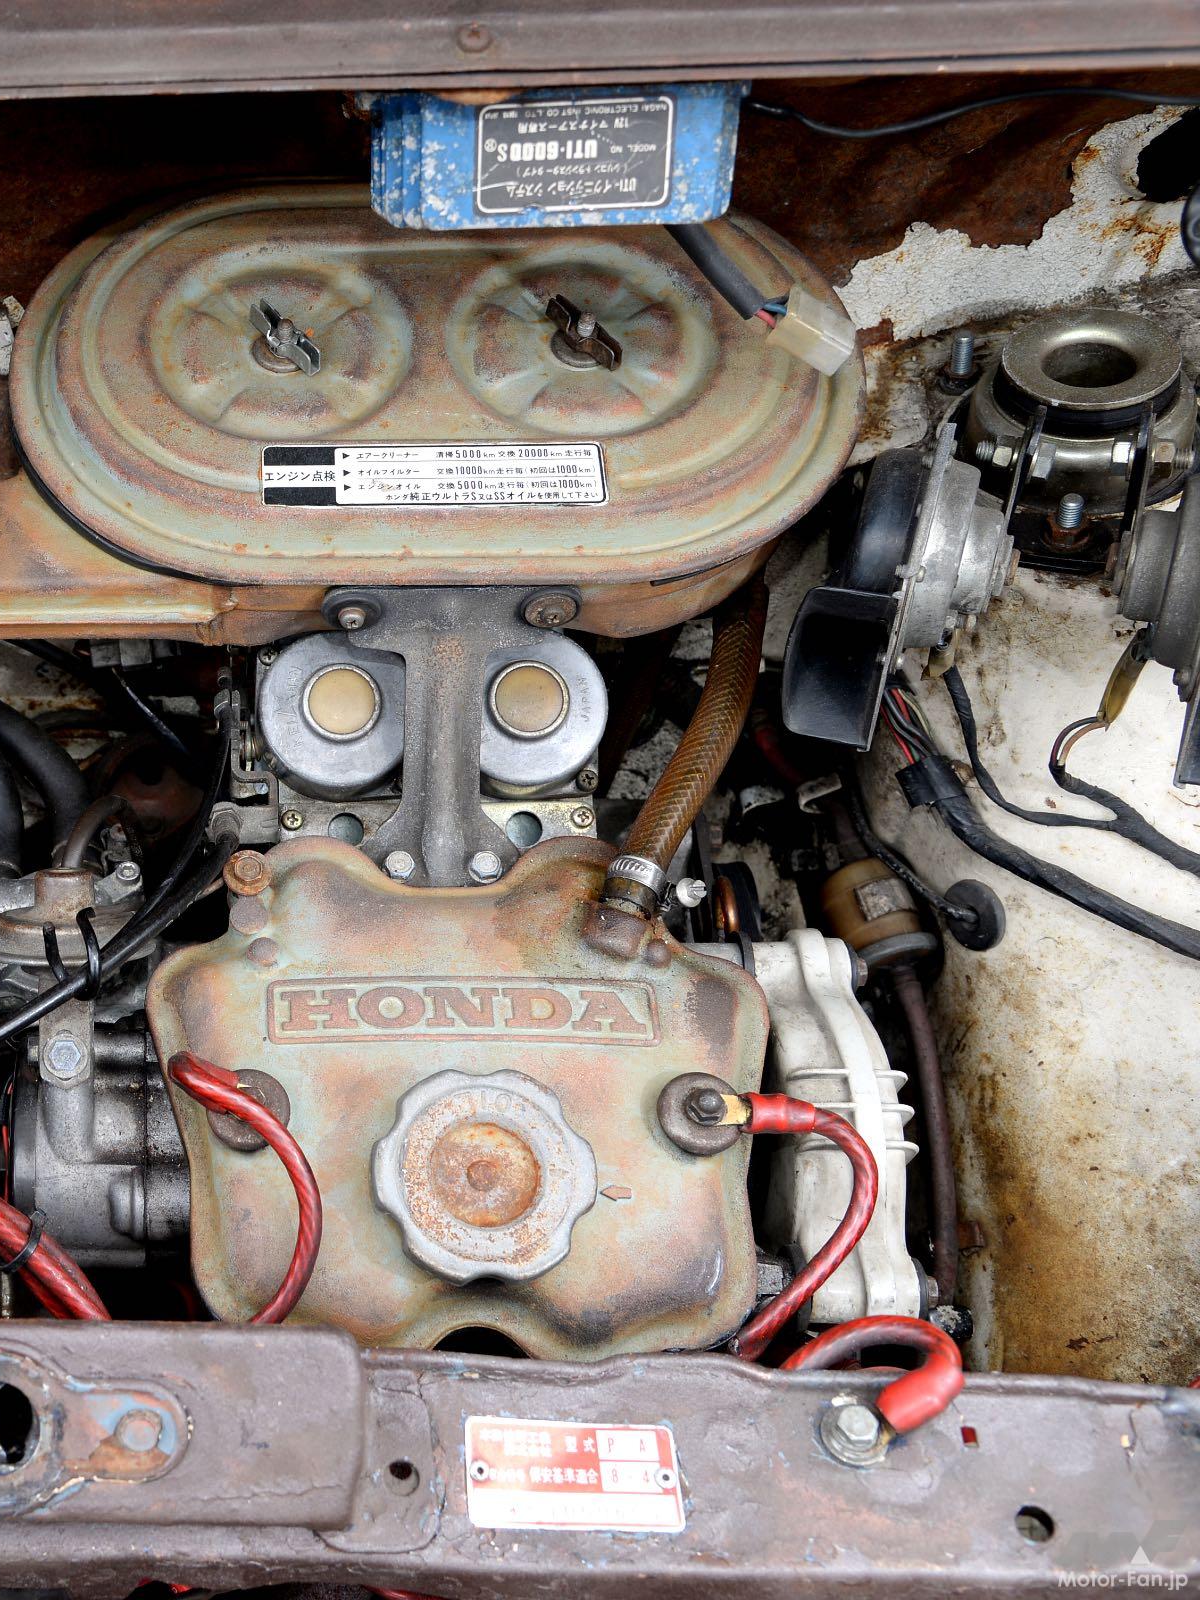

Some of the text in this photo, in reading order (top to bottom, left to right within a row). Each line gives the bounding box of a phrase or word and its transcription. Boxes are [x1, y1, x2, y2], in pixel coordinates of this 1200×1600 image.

[355, 450, 420, 461] エアークリーナー
[264, 470, 336, 483] エンジン点検
[280, 986, 647, 1034] HONDA
